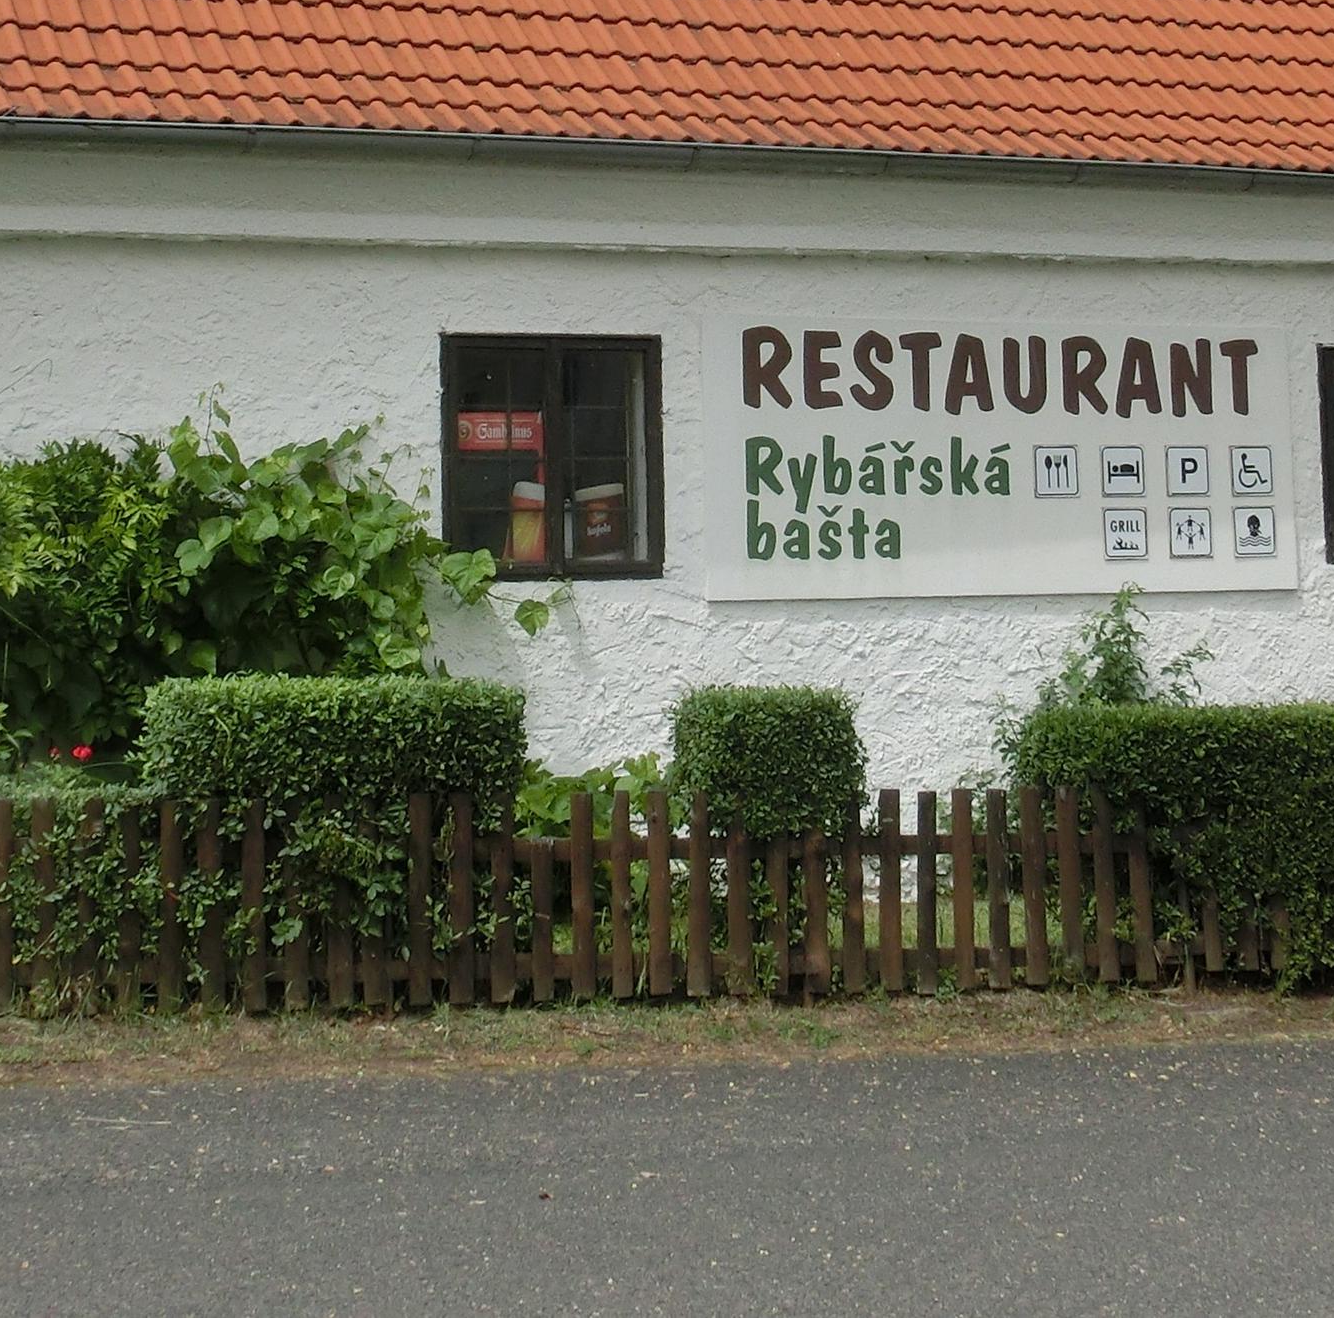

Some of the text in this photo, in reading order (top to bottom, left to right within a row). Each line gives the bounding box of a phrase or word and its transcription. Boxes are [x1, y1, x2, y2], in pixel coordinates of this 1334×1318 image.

[742, 325, 1258, 418] RESTAURANT
[477, 423, 533, 439] Gambinus
[745, 435, 1011, 514] Rybářská
[1180, 457, 1199, 484] P
[747, 499, 901, 561] bašta
[1110, 520, 1141, 533] GRILL
